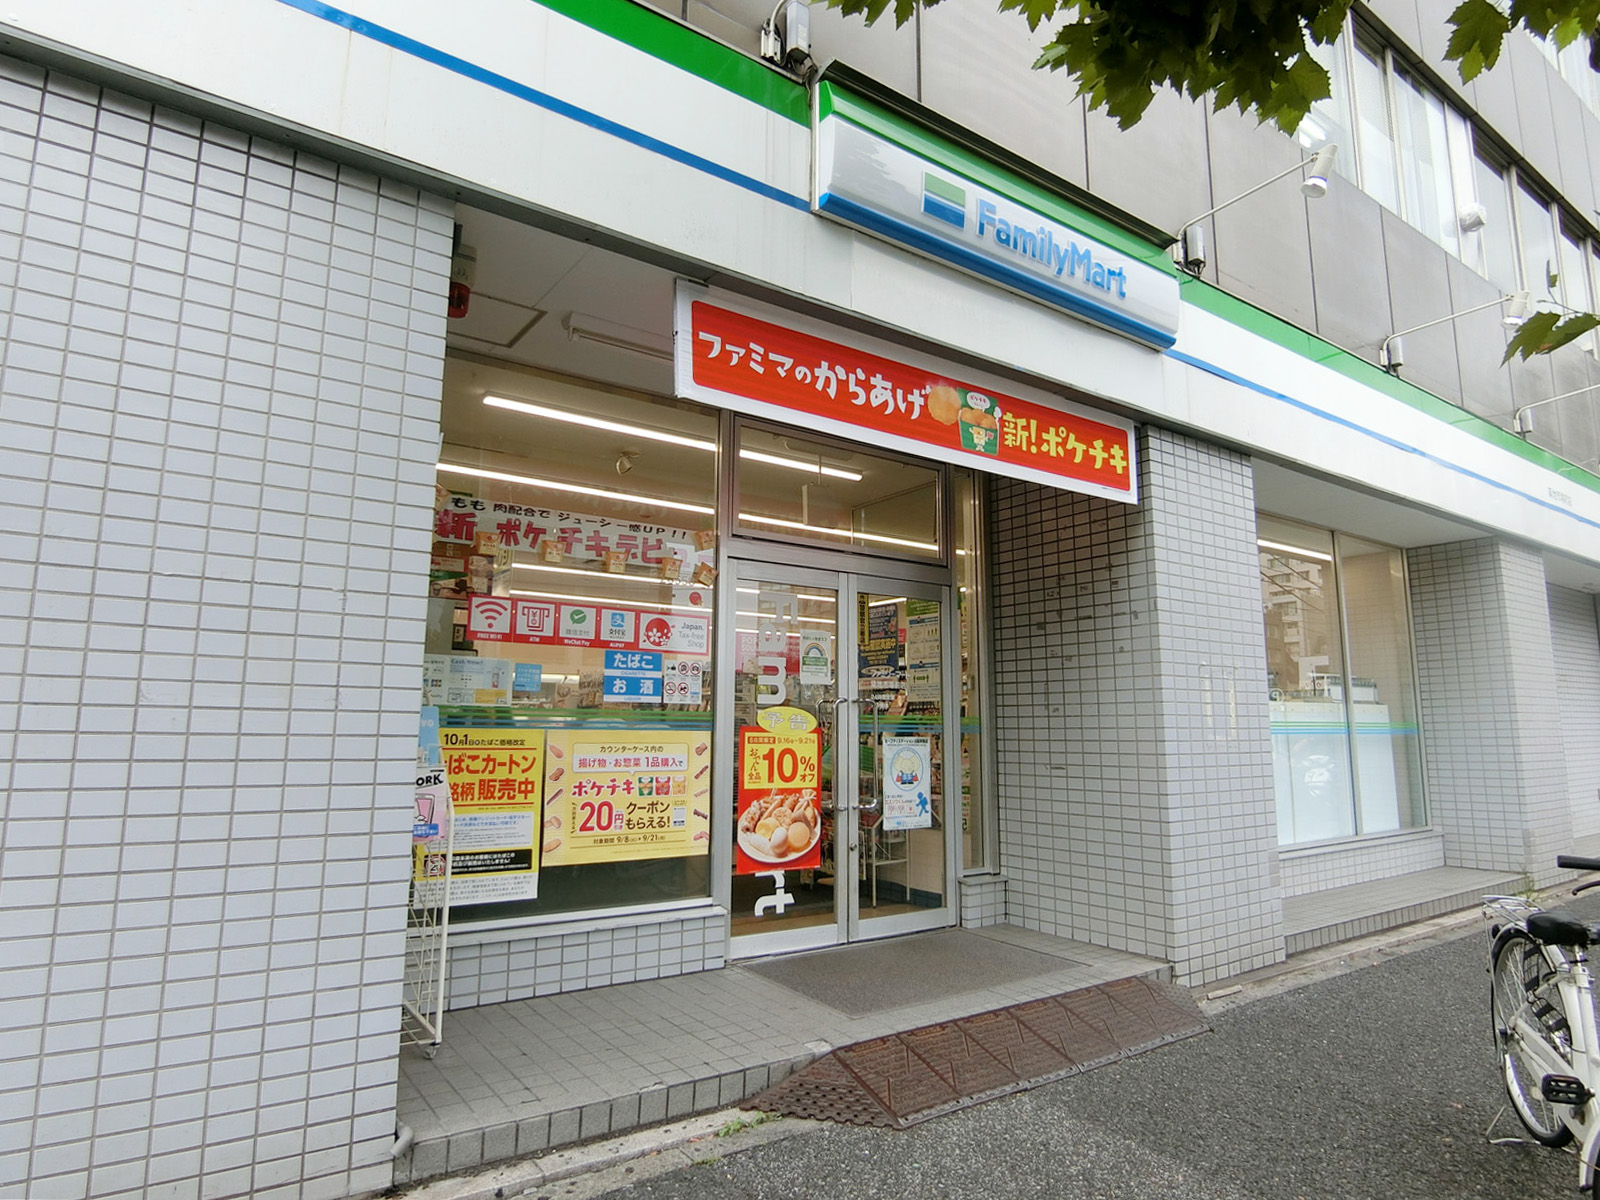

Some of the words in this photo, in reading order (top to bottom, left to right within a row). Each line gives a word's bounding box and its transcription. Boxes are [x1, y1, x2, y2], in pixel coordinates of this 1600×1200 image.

[976, 197, 1127, 299] FamilyMart
[698, 330, 932, 420] ファミマのからあげ
[451, 496, 486, 512] もも
[434, 509, 478, 541] 新
[613, 653, 654, 669] たばこ
[763, 711, 808, 731] 予告
[444, 752, 537, 776] ばこカートン
[571, 777, 635, 797] ポケチキ
[626, 799, 671, 816] クーポン
[625, 816, 671, 830] もらえる!
